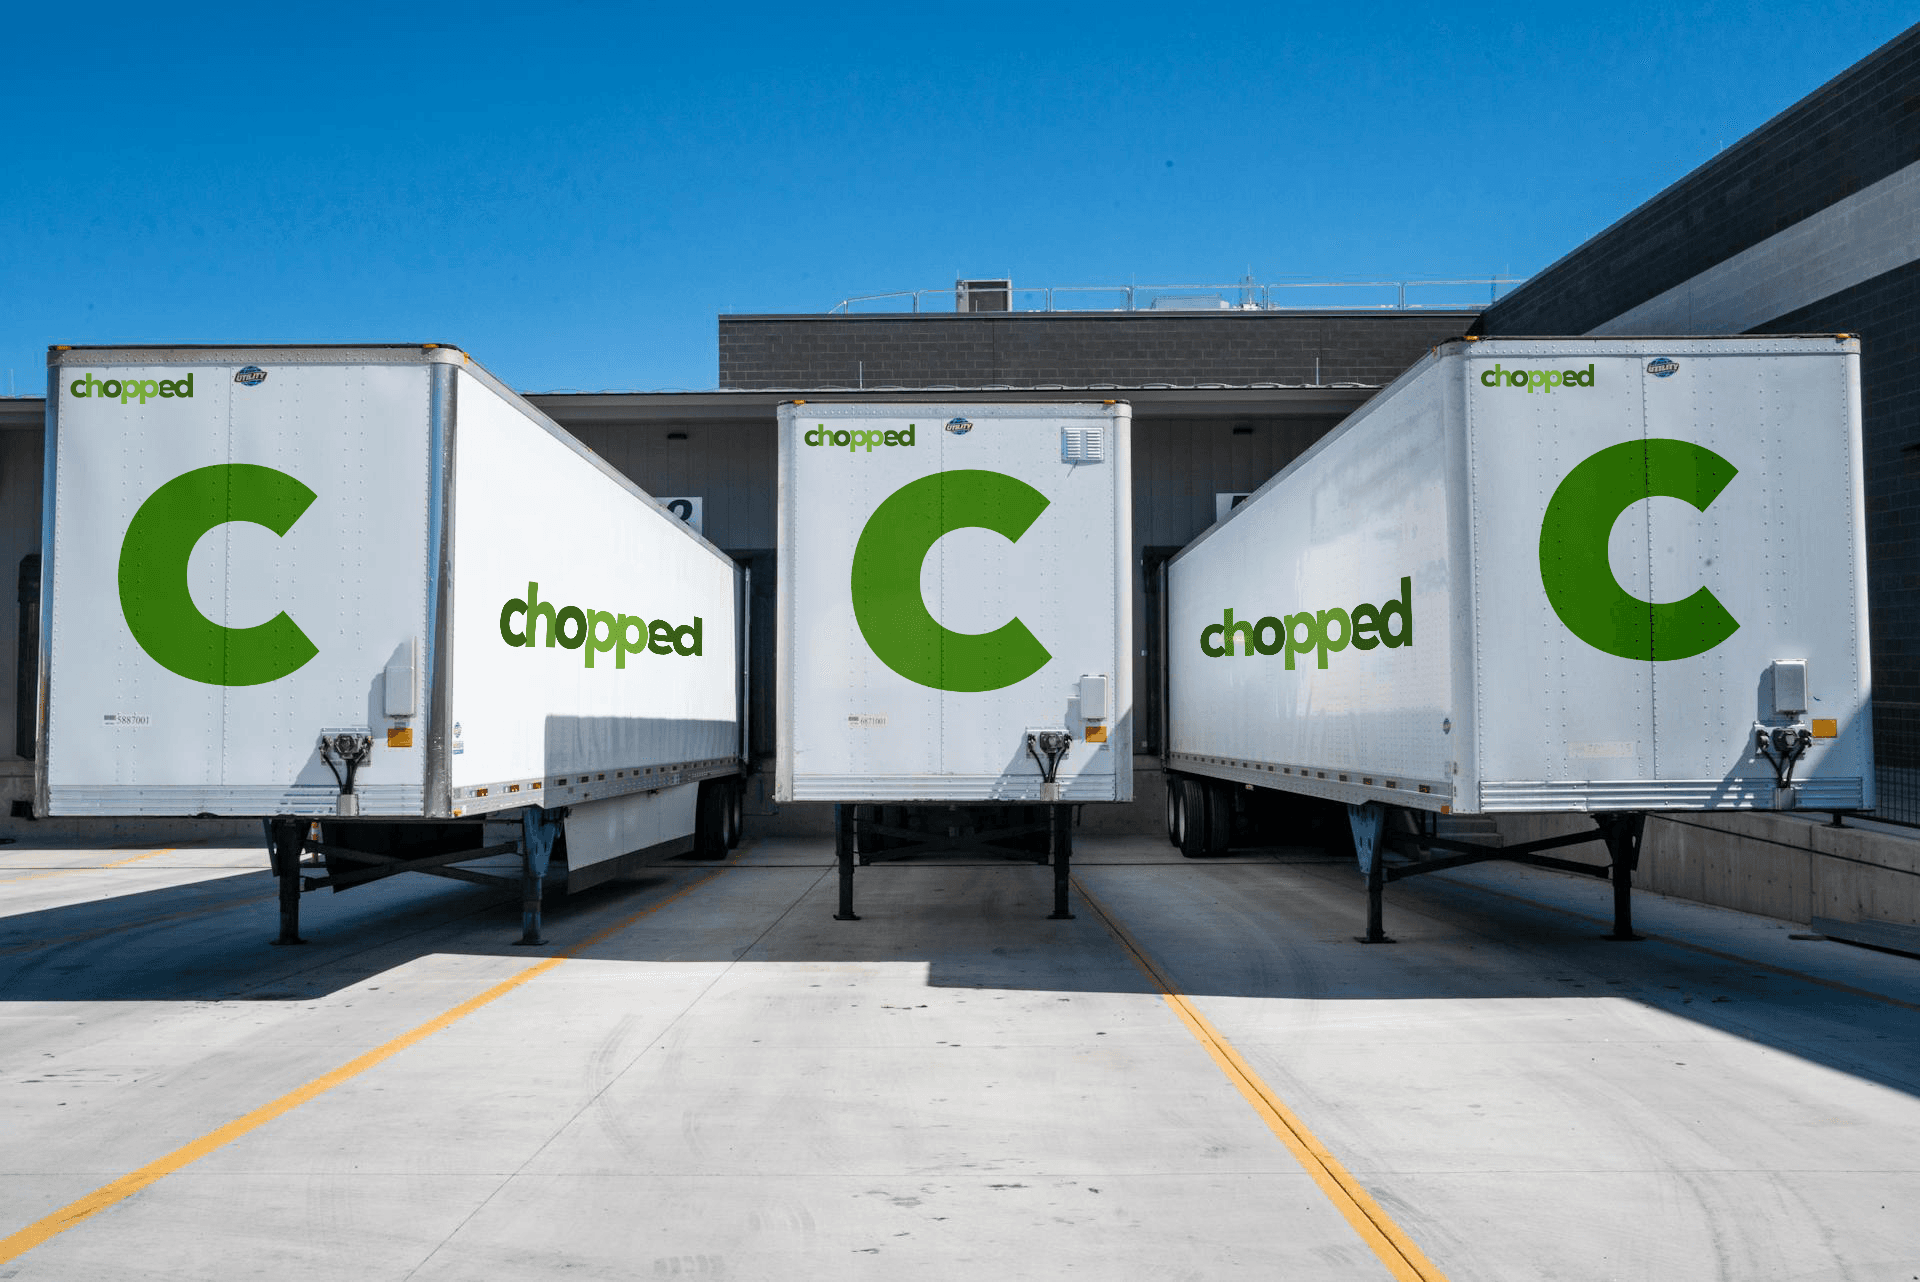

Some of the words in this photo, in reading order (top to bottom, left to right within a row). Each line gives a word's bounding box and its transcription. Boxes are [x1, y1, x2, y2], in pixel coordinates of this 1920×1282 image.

[71, 373, 193, 404] chopped
[1481, 364, 1594, 393] chopped
[804, 424, 915, 452] chopped
[500, 582, 702, 669] chopped
[1200, 576, 1412, 670] chopped
